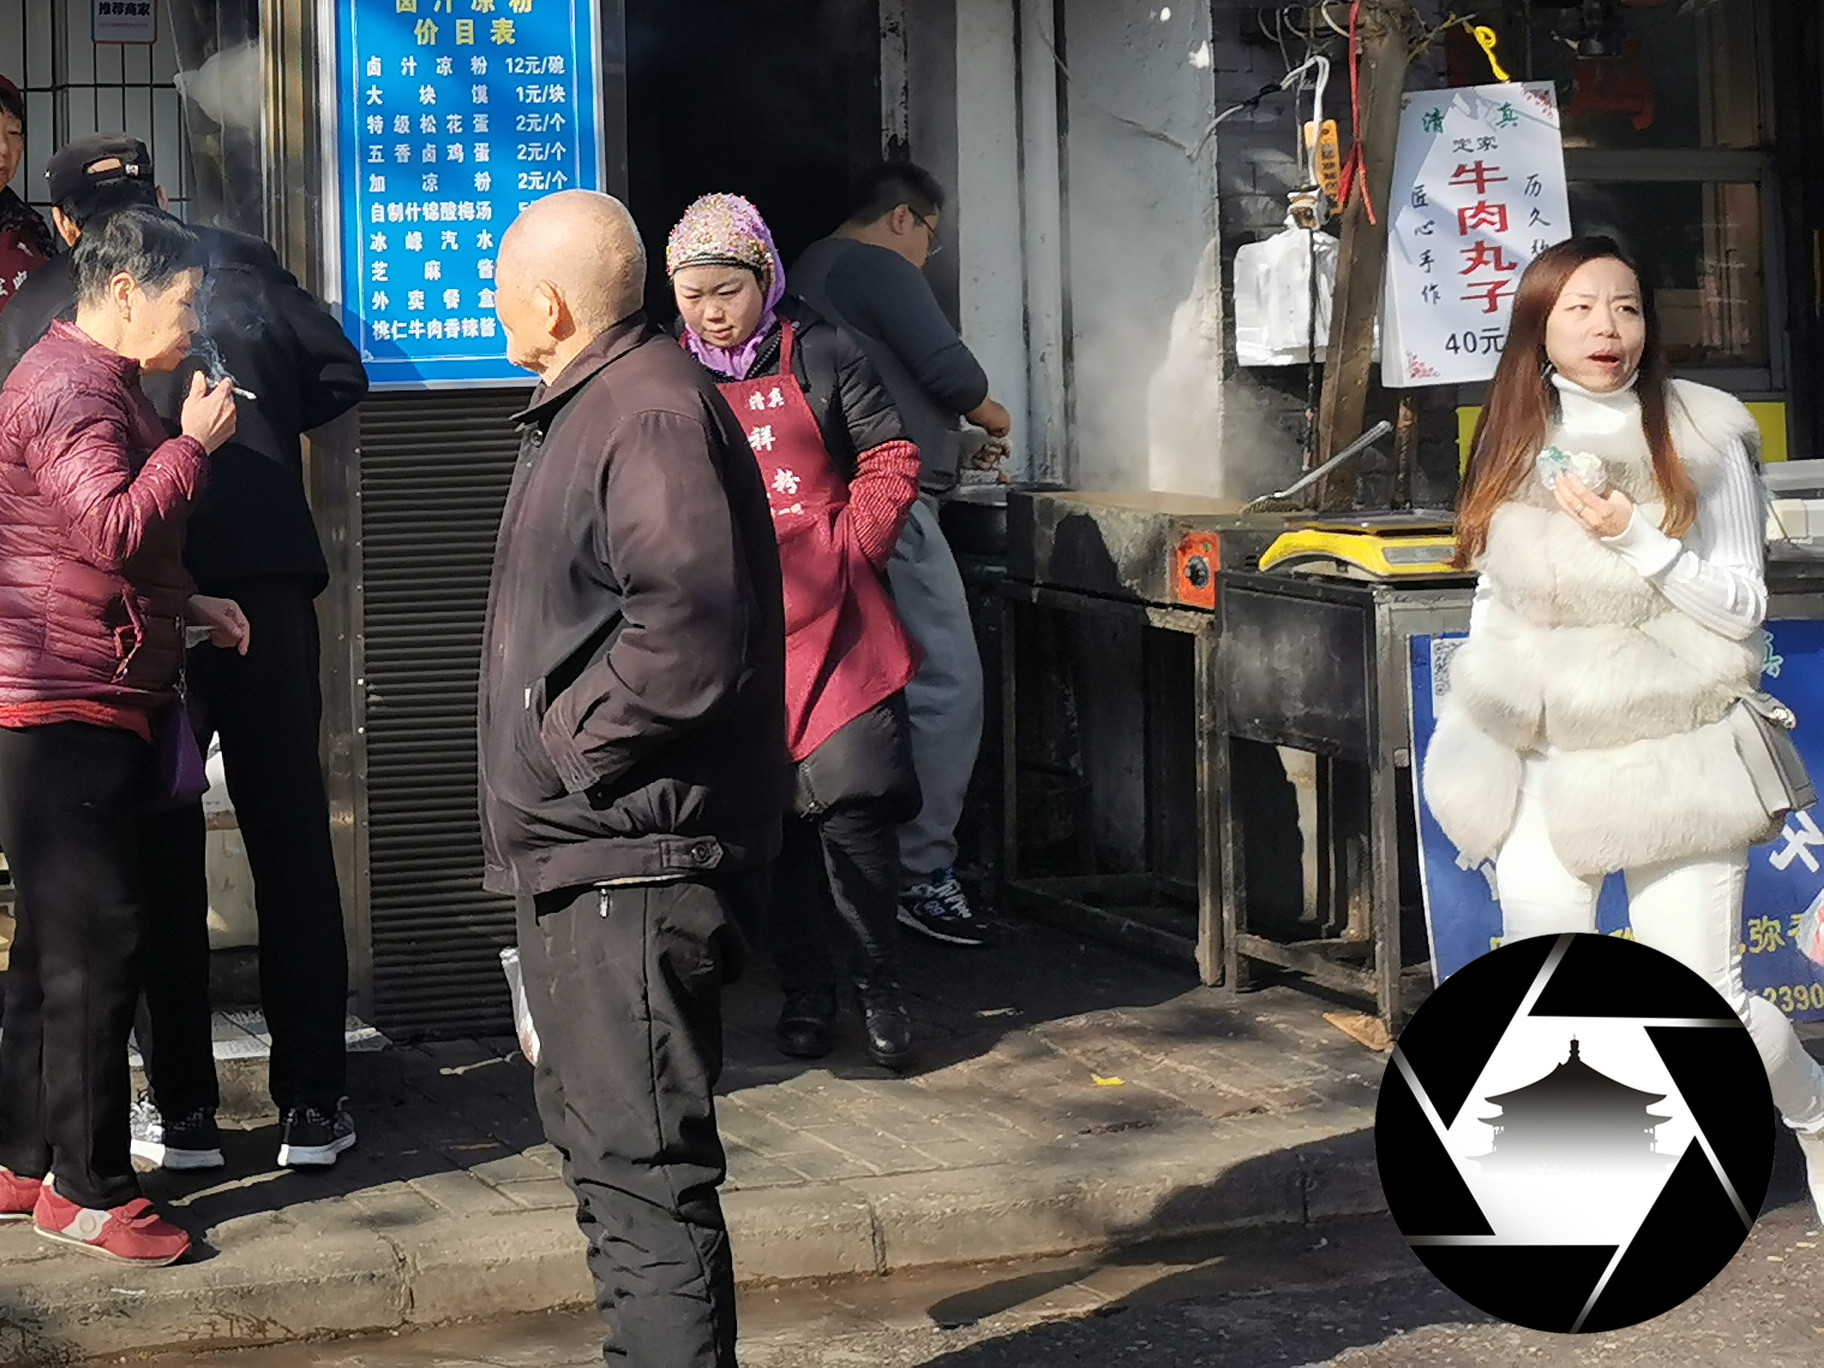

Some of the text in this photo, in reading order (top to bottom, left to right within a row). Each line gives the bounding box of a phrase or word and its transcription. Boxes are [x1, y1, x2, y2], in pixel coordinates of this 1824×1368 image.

[414, 17, 516, 46] 价目表
[366, 55, 566, 77] 卤汁凉粉 12元/碗
[366, 83, 566, 105] 大块馍 1元/块
[366, 112, 566, 134] 特级松花蛋 2元/个
[1422, 101, 1519, 135] 清真
[367, 141, 567, 163] 五香卤鸡蛋 2元/个
[1452, 135, 1499, 153] 定家
[369, 170, 568, 192] 加凉粉 2元/个
[370, 200, 493, 223] 自制什锦酸梅汤
[370, 229, 494, 252] 冰峰汽水
[1411, 186, 1442, 306] 匠心手作
[1448, 159, 1518, 315] 牛肉丸子
[371, 258, 495, 282] 芝麻酱
[372, 287, 495, 312] 外卖餐盒
[1445, 327, 1506, 355] 40元
